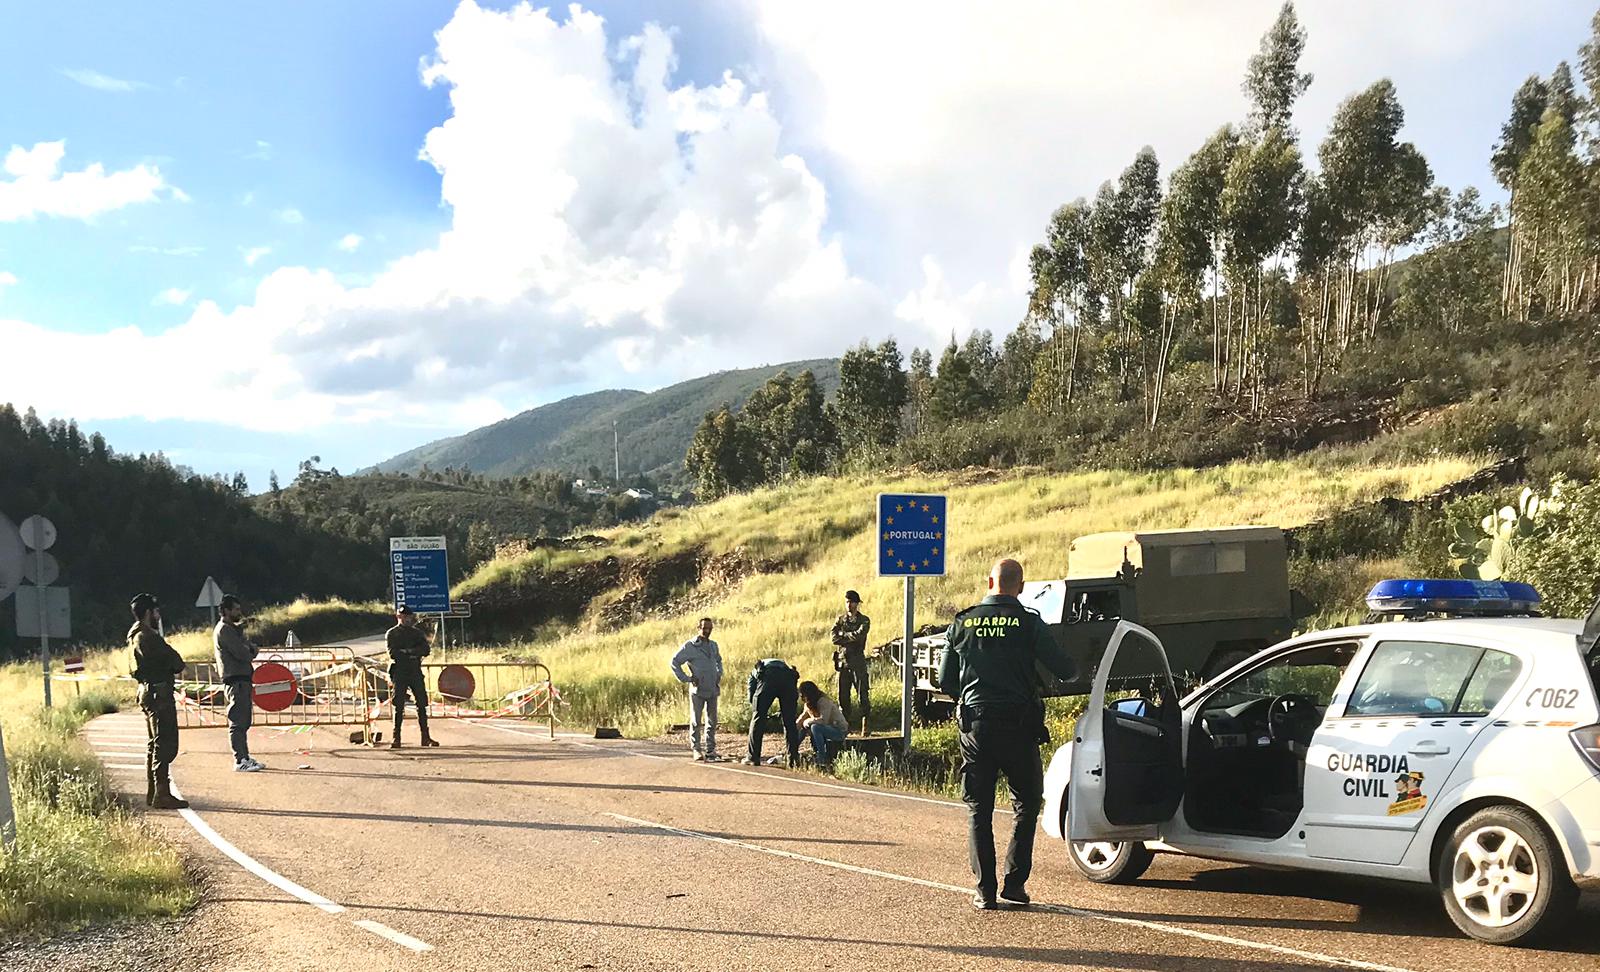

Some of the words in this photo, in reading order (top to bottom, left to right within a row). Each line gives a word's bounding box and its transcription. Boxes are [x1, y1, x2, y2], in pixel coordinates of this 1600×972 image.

[890, 531, 935, 540] PORTUGAL
[964, 616, 1020, 628] GUARDIA
[976, 627, 1006, 637] CIVIL
[1541, 688, 1579, 709] 062
[1327, 754, 1409, 774] GUARDIA
[1343, 778, 1389, 798] CIVIL
